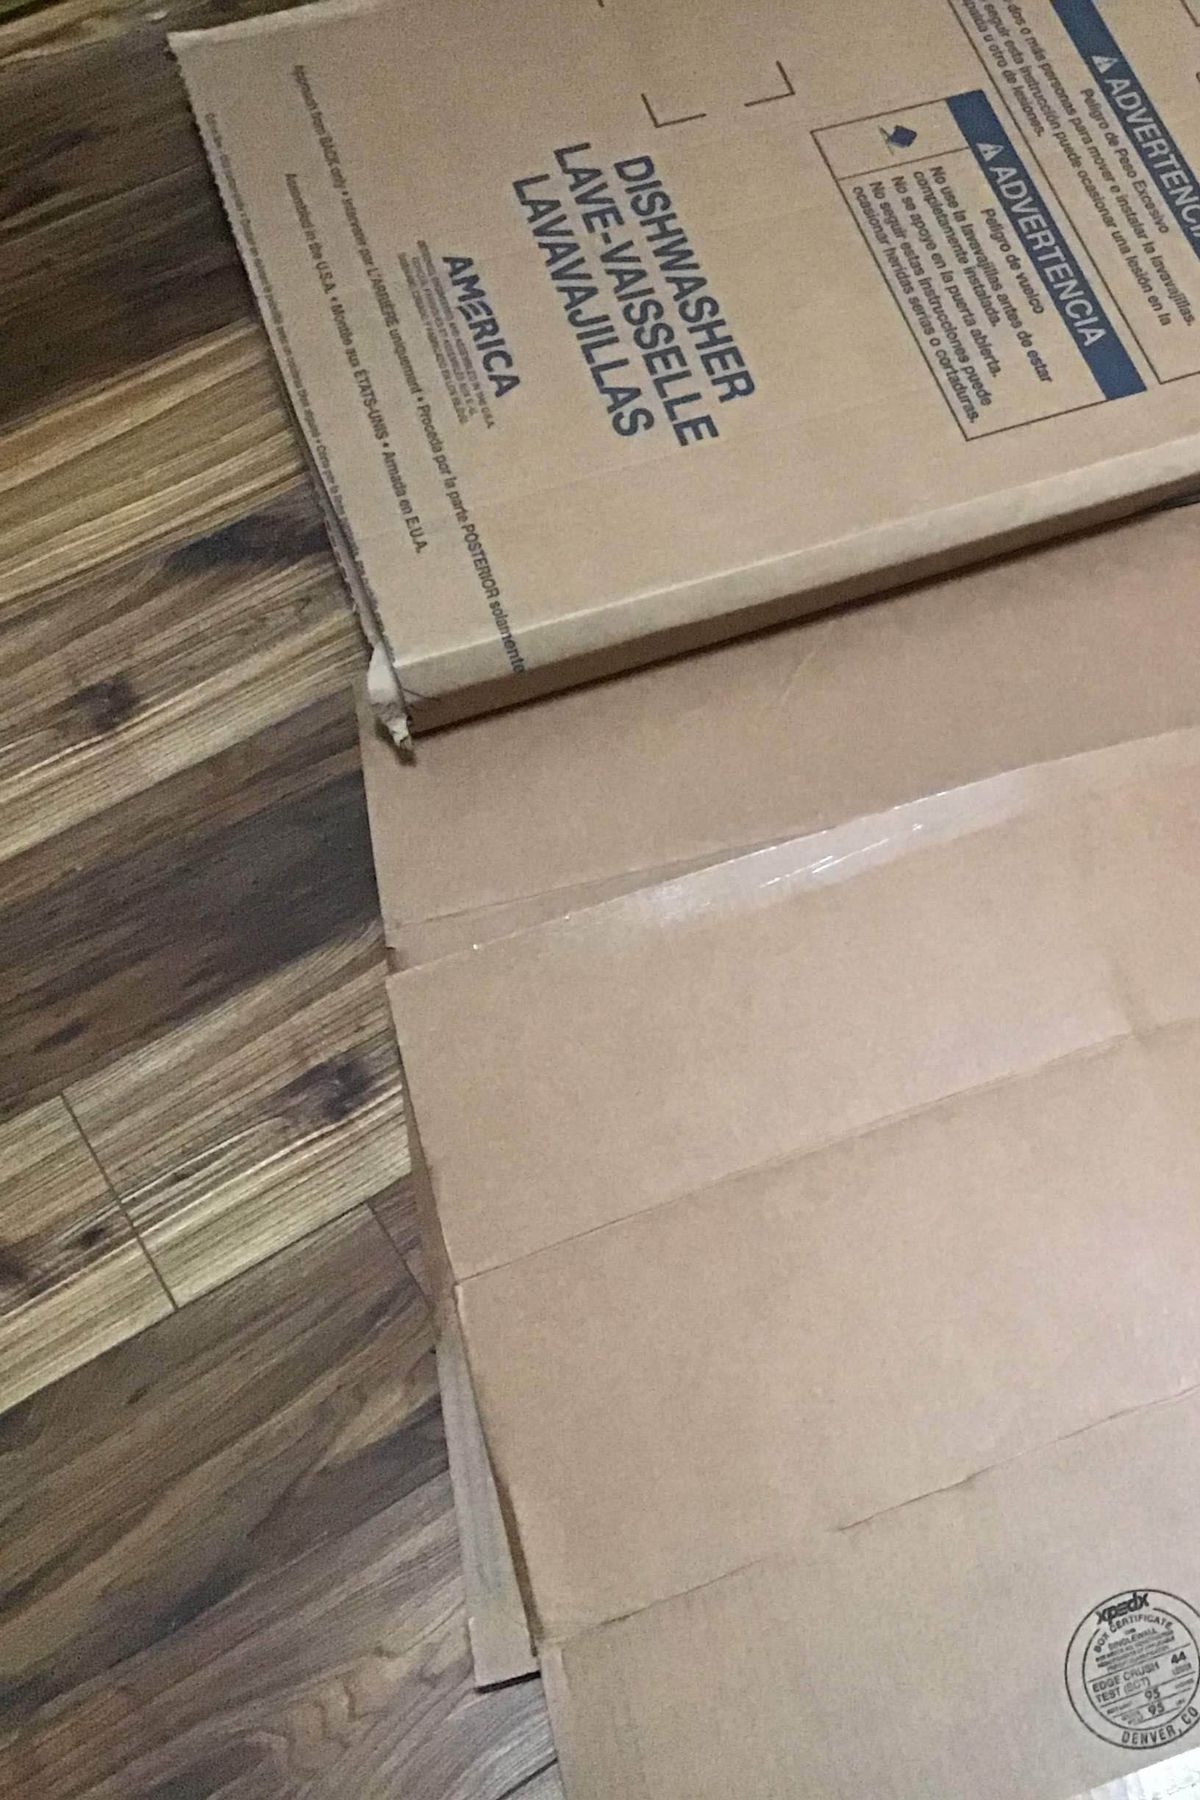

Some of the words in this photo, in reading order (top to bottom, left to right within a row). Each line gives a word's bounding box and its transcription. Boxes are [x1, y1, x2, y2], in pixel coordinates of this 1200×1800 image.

[983, 34, 994, 42] u
[989, 44, 1008, 67] otro
[1002, 70, 1017, 84] de
[1012, 86, 1044, 137] lesiones.
[1007, 4, 1026, 25] dos
[1025, 37, 1046, 62] más
[1038, 63, 1077, 115] personas
[1068, 117, 1093, 144] para
[1087, 146, 1115, 182] mover
[1116, 195, 1148, 239] instalar
[1142, 241, 1155, 254] la
[319, 135, 340, 166] BACK
[984, 3, 1010, 37] seguir
[1004, 40, 1024, 64] esta
[1019, 66, 1061, 129] instrucción
[1052, 132, 1082, 168] puede
[1077, 170, 1117, 227] ocasionar
[1111, 231, 1131, 254] una
[1125, 255, 1153, 293] lesión
[1148, 296, 1163, 311] en
[1158, 313, 1171, 326] la
[1080, 88, 1109, 129] Peligro
[1104, 132, 1119, 146] de
[1114, 148, 1137, 178] Peso
[1132, 180, 1169, 233] Excesivo
[330, 167, 346, 188] only
[891, 176, 908, 193] No
[902, 196, 916, 211] se
[305, 230, 316, 241] in
[309, 242, 322, 260] the
[910, 214, 937, 250] apoye
[913, 171, 969, 264] completamente
[963, 266, 1000, 327] instalada.
[358, 249, 374, 265] par
[930, 166, 946, 184] No
[940, 186, 959, 208] use
[953, 210, 966, 222] la
[960, 224, 1003, 291] lavavajillas
[997, 294, 1022, 329] antes
[1016, 331, 1032, 347] de
[1027, 350, 1052, 382] estar
[931, 253, 946, 269] en
[981, 208, 1011, 252] Peligro
[1005, 255, 1021, 270] de
[1016, 272, 1044, 314] vuelco
[989, 167, 1106, 346] ADVERTENCIA
[316, 261, 336, 294] U.S.A.
[553, 142, 719, 446] LAVE-VAISSELLE
[613, 156, 754, 403] DISHWASHER
[869, 181, 885, 199] No
[878, 202, 907, 239] seguir
[900, 242, 925, 276] estas
[918, 277, 970, 363] instrucciones
[960, 366, 992, 406] puede
[940, 271, 953, 283] la
[512, 174, 654, 436] LAVAVAJILLAS
[853, 186, 890, 245] ocasionar
[883, 247, 914, 294] heridas
[908, 297, 935, 335] serias
[929, 338, 941, 347] o
[935, 349, 979, 423] cortaduras.
[945, 285, 976, 326] puerta
[443, 255, 521, 398] AMERICA
[346, 348, 359, 367] aux
[389, 329, 423, 394] uniquement
[970, 329, 1001, 377] abierta.
[354, 369, 389, 440] ÉTATS-UNIS
[417, 404, 443, 453] Proceda
[382, 452, 406, 497] Armada
[433, 454, 451, 474] por
[444, 477, 456, 488] la
[400, 500, 412, 514] en
[446, 491, 468, 522] parte
[405, 516, 427, 553] E.U.A.
[461, 524, 500, 599] POSTERIOR
[490, 601, 527, 676] solamente
[1096, 1592, 1149, 1626] xpedx
[1110, 1614, 1174, 1633] CERTIFICATE
[1092, 1675, 1121, 1693] EDGE
[1171, 1651, 1187, 1664] 44
[1095, 1687, 1120, 1703] TEST
[1144, 1687, 1161, 1701] 95
[1148, 1701, 1165, 1716] 95
[1121, 1725, 1183, 1745] DENVER,
[1181, 1706, 1199, 1725] CO
